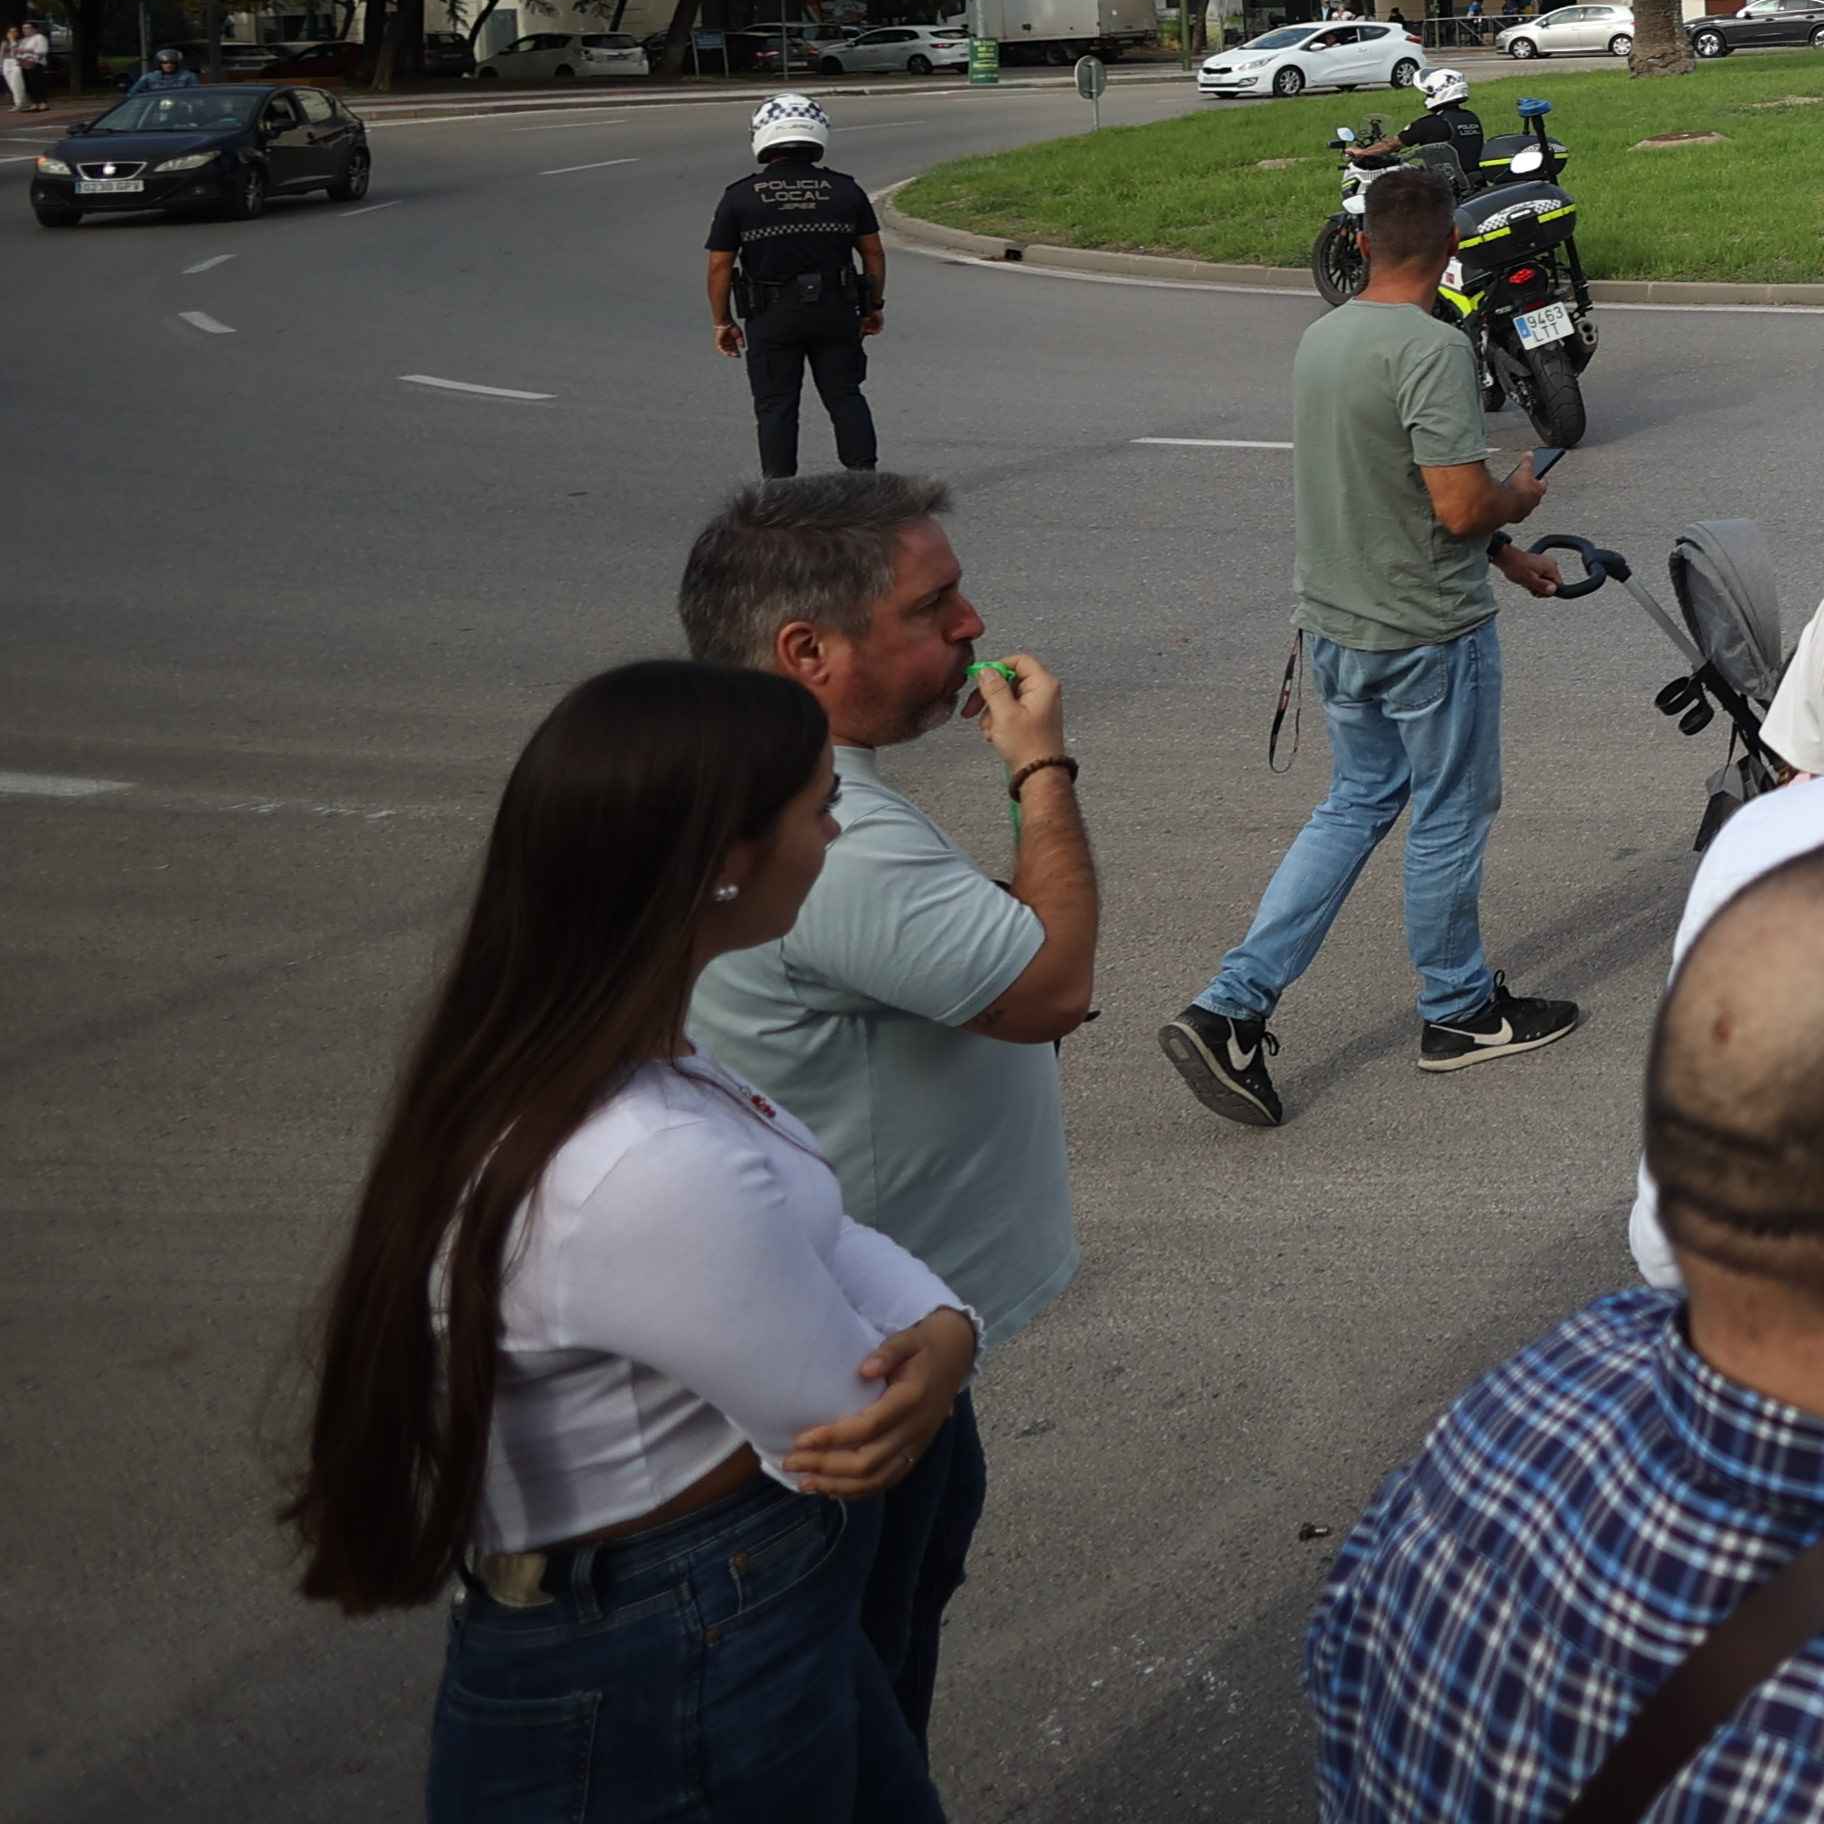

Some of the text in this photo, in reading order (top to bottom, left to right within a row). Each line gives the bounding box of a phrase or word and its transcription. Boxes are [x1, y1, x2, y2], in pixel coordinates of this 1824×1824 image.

[753, 179, 832, 192] POLICIA
[761, 190, 830, 203] LOCAL
[1526, 305, 1565, 329] 9463
[1532, 320, 1561, 343] LTT
